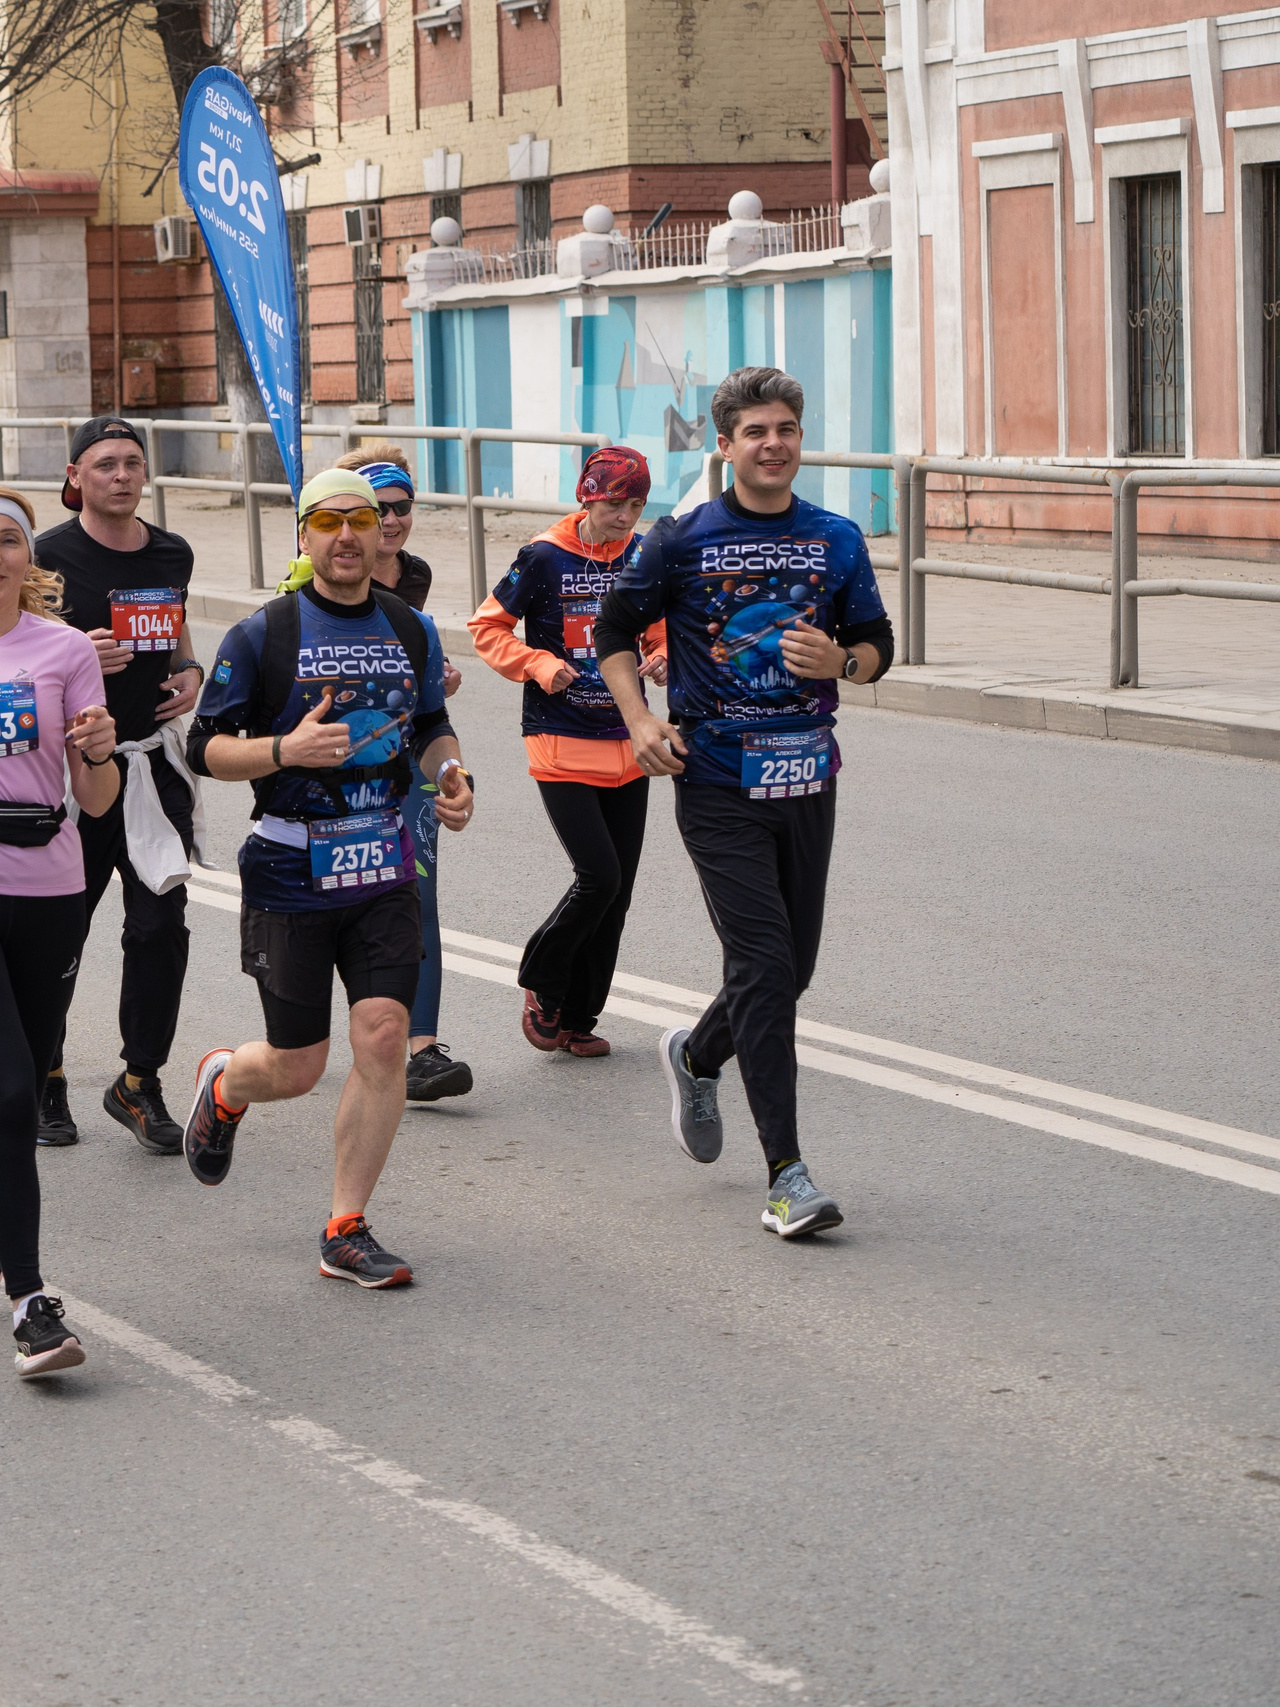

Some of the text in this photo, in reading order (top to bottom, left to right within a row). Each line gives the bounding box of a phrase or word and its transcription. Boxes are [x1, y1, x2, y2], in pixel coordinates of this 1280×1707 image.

[701, 556, 827, 572] КОСМОС
[577, 572, 621, 582] ПРОС
[128, 614, 173, 637] 1044
[298, 659, 414, 677] КОСМОС
[22, 715, 32, 726] E
[760, 757, 816, 784] 2250
[338, 821, 373, 832] КОСМОС
[345, 817, 372, 825] ПРОСТО
[332, 840, 384, 873] 2375
